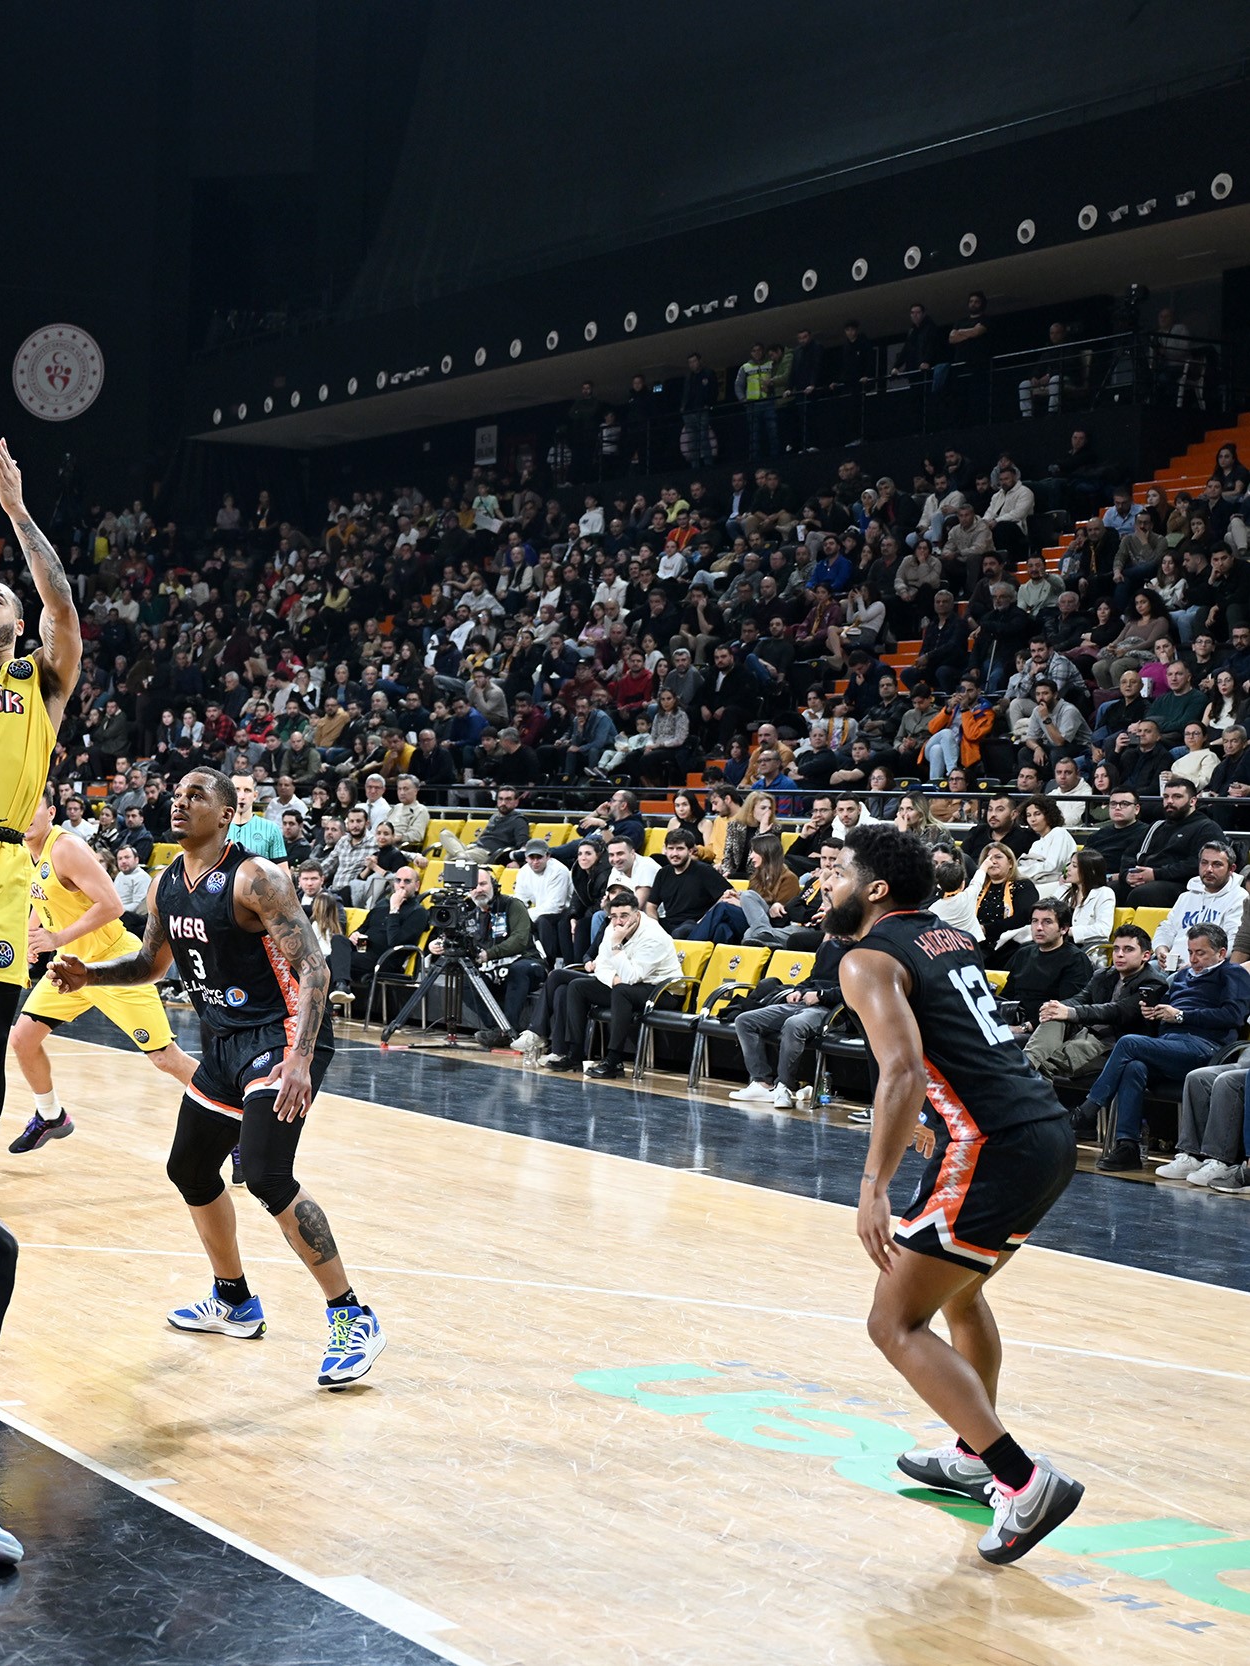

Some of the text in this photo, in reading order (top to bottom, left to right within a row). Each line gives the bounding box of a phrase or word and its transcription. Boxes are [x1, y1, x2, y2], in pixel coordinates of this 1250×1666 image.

[30, 882, 49, 900] SK
[169, 914, 209, 943] MSB
[188, 948, 207, 980] 3
[948, 965, 1015, 1046] 12
